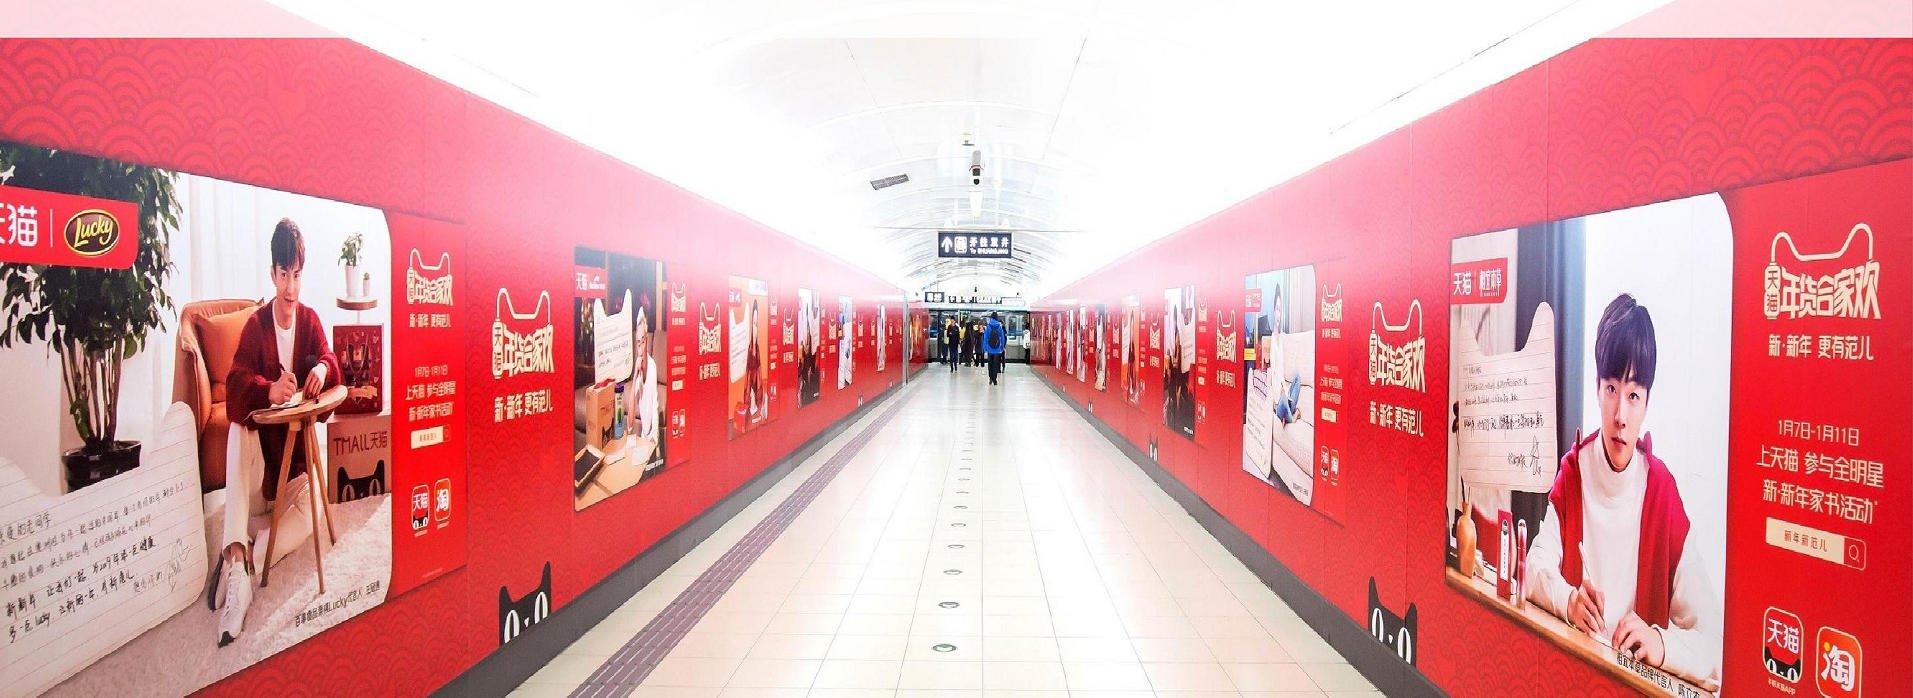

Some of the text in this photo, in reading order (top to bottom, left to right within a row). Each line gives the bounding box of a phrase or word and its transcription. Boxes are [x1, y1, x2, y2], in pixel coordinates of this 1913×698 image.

[74, 214, 113, 249] Lucky
[1454, 271, 1471, 296] 天猫
[1780, 261, 1882, 320] 年货合家欢
[503, 323, 555, 378] 年货合家欢
[1817, 335, 1874, 360] 更有范儿
[1377, 336, 1426, 393] 年货合家欢
[524, 389, 553, 417] 更有范儿
[1394, 406, 1424, 438] 更有范儿
[1778, 420, 1860, 447] 1月7日-1月11日
[369, 430, 388, 449] 天猫
[1756, 444, 1885, 489] 上天猫 参与全明星
[413, 493, 428, 511] 天猫
[1784, 530, 1828, 553] 新年新范儿
[1767, 617, 1800, 655] 天猫
[1820, 641, 1856, 692] 淘
